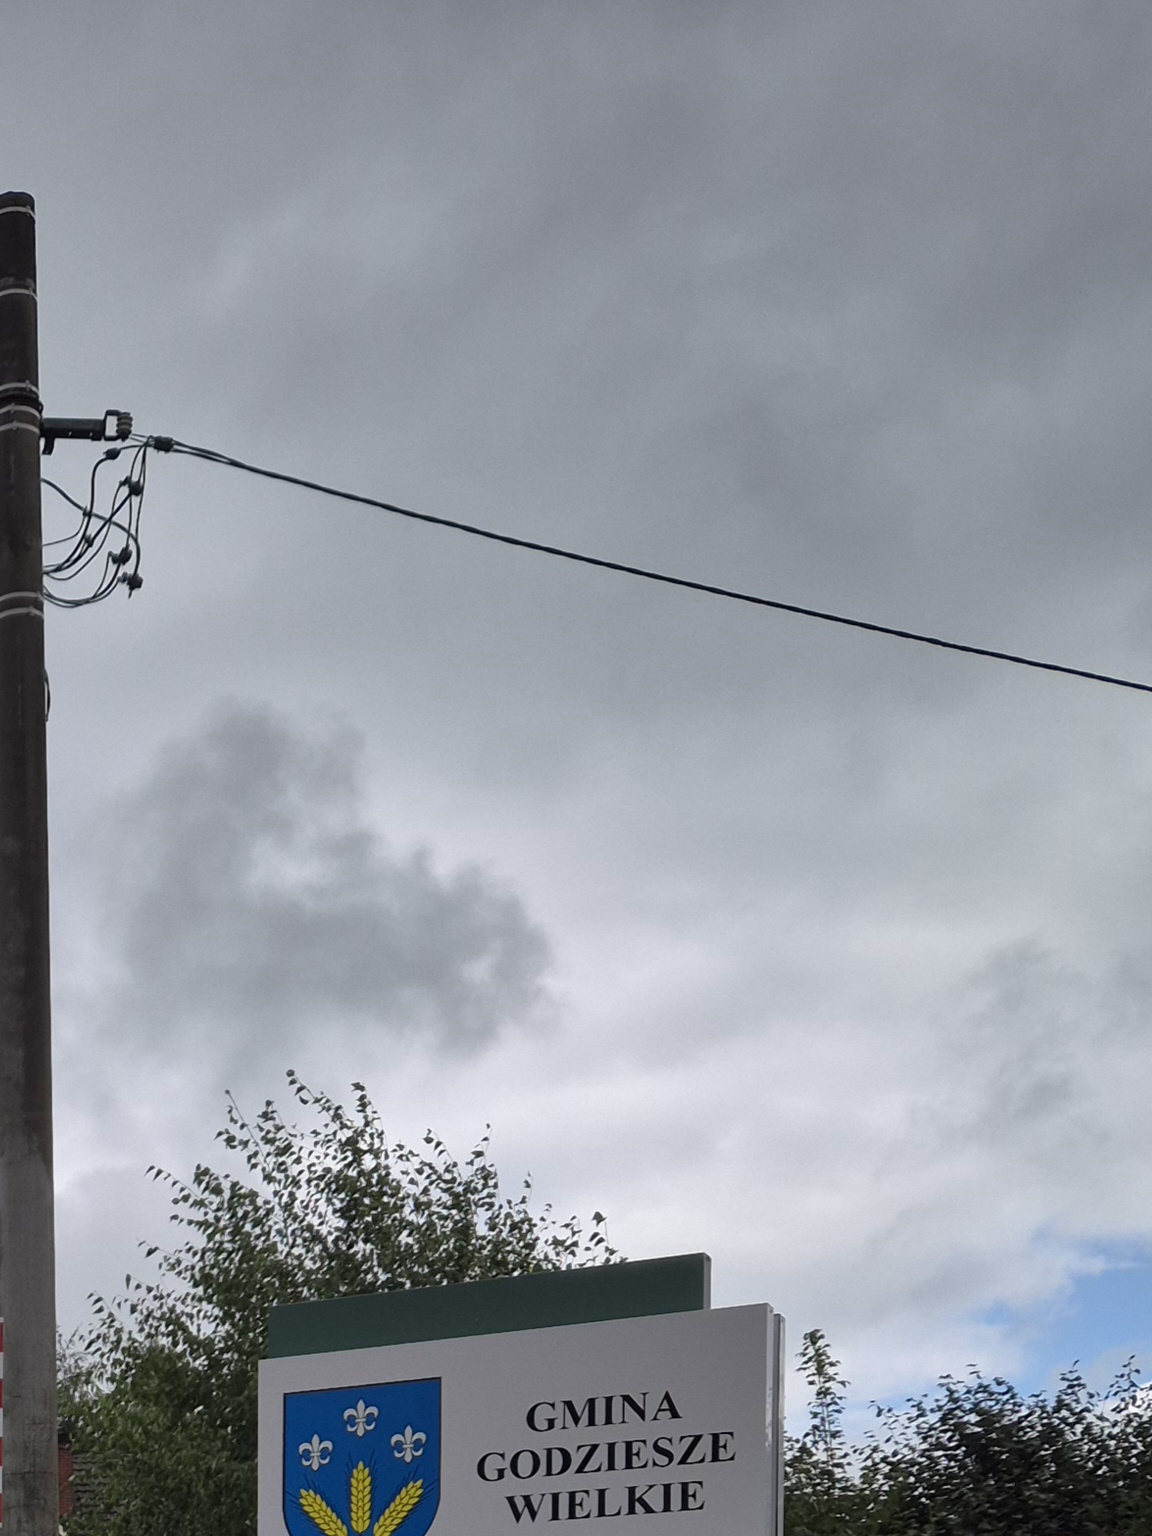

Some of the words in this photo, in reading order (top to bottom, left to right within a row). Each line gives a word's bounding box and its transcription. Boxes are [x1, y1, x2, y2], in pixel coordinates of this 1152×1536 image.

[525, 1390, 682, 1433] GMINA
[476, 1431, 736, 1482] GODZIESZE
[504, 1480, 706, 1524] WIELKIE
